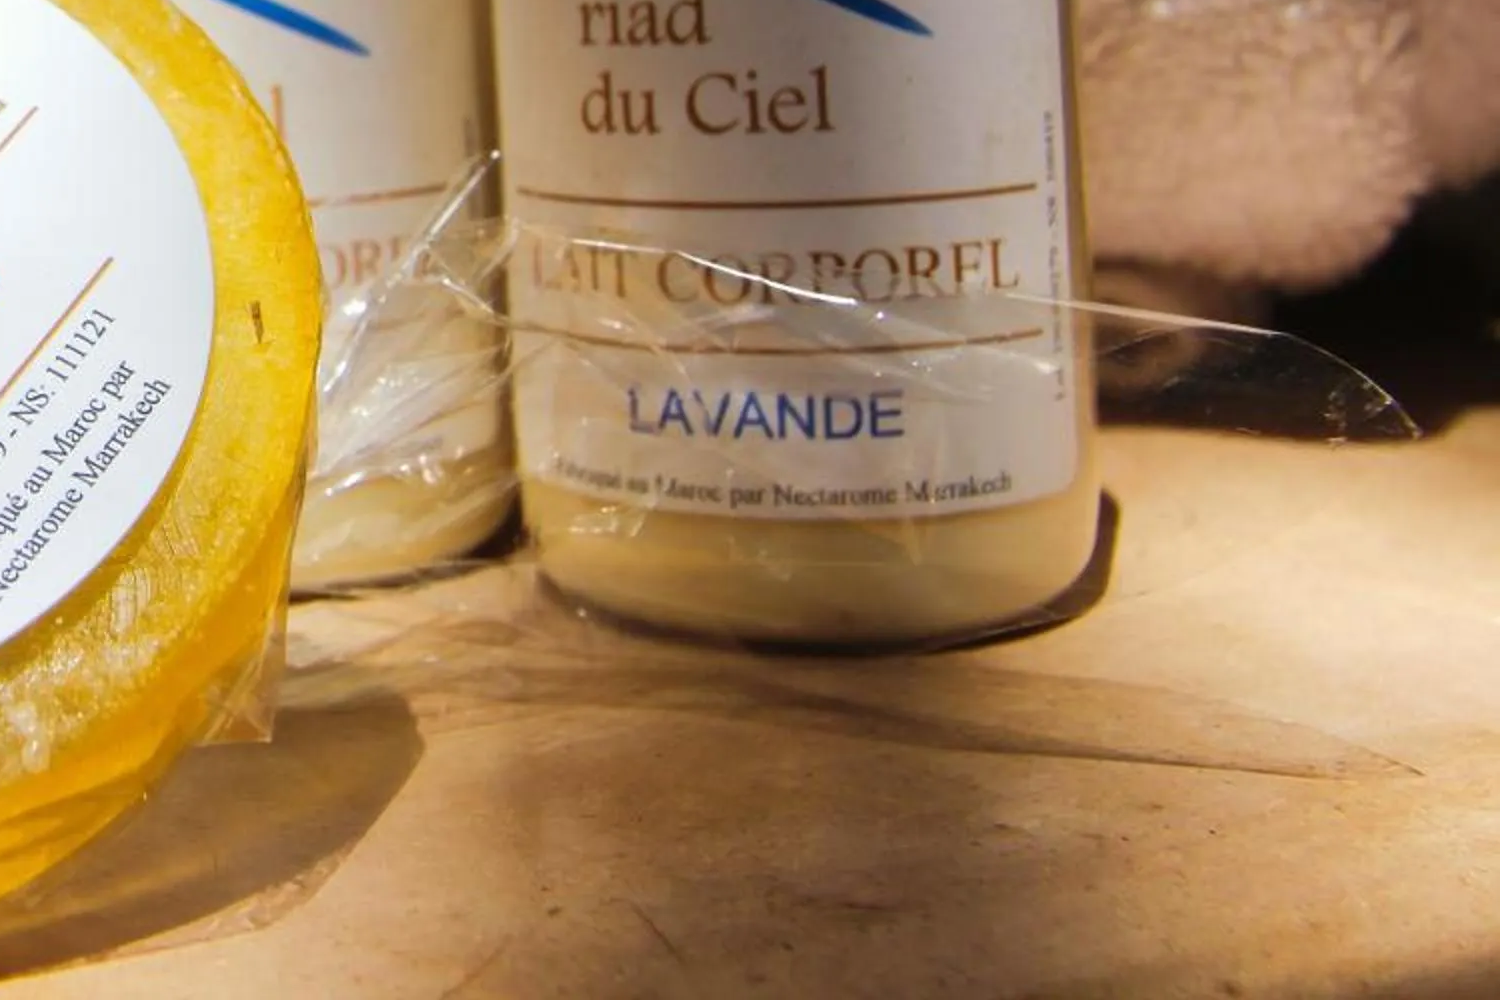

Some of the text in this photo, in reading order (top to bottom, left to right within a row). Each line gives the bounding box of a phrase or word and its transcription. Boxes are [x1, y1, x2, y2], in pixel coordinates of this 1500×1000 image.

[580, 66, 836, 136] du Ciel
[533, 238, 632, 298] LAIT
[8, 384, 56, 427] NS:
[45, 308, 117, 384] 111121
[24, 464, 53, 495] au
[41, 397, 107, 466] Maroc
[101, 359, 137, 402] par
[72, 376, 173, 489] Marrakech
[626, 387, 906, 441] LAVANDE
[729, 481, 766, 509] par
